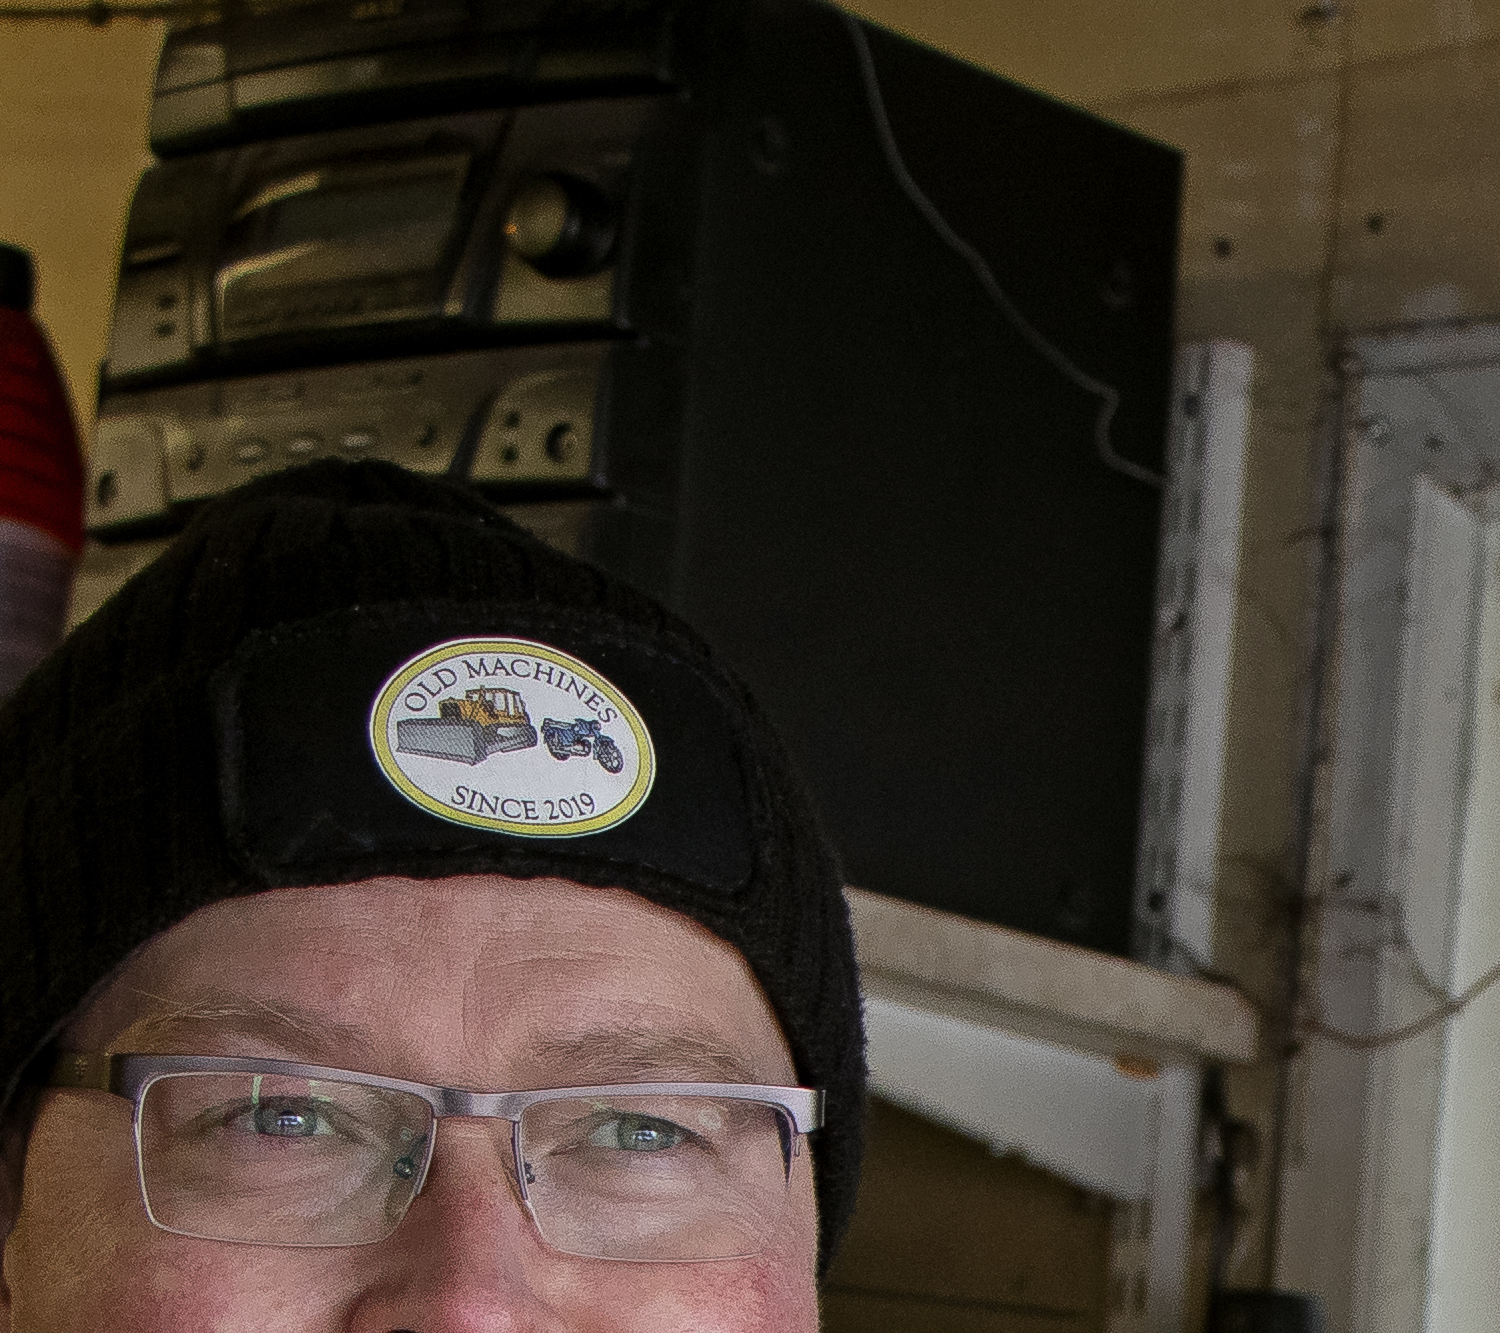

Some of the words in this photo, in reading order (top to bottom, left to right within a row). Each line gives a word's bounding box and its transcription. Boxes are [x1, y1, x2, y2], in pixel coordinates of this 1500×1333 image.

[403, 667, 458, 713] OLD
[461, 657, 619, 726] MACHINES
[451, 785, 540, 820] SINCE
[544, 792, 596, 821] 2019
